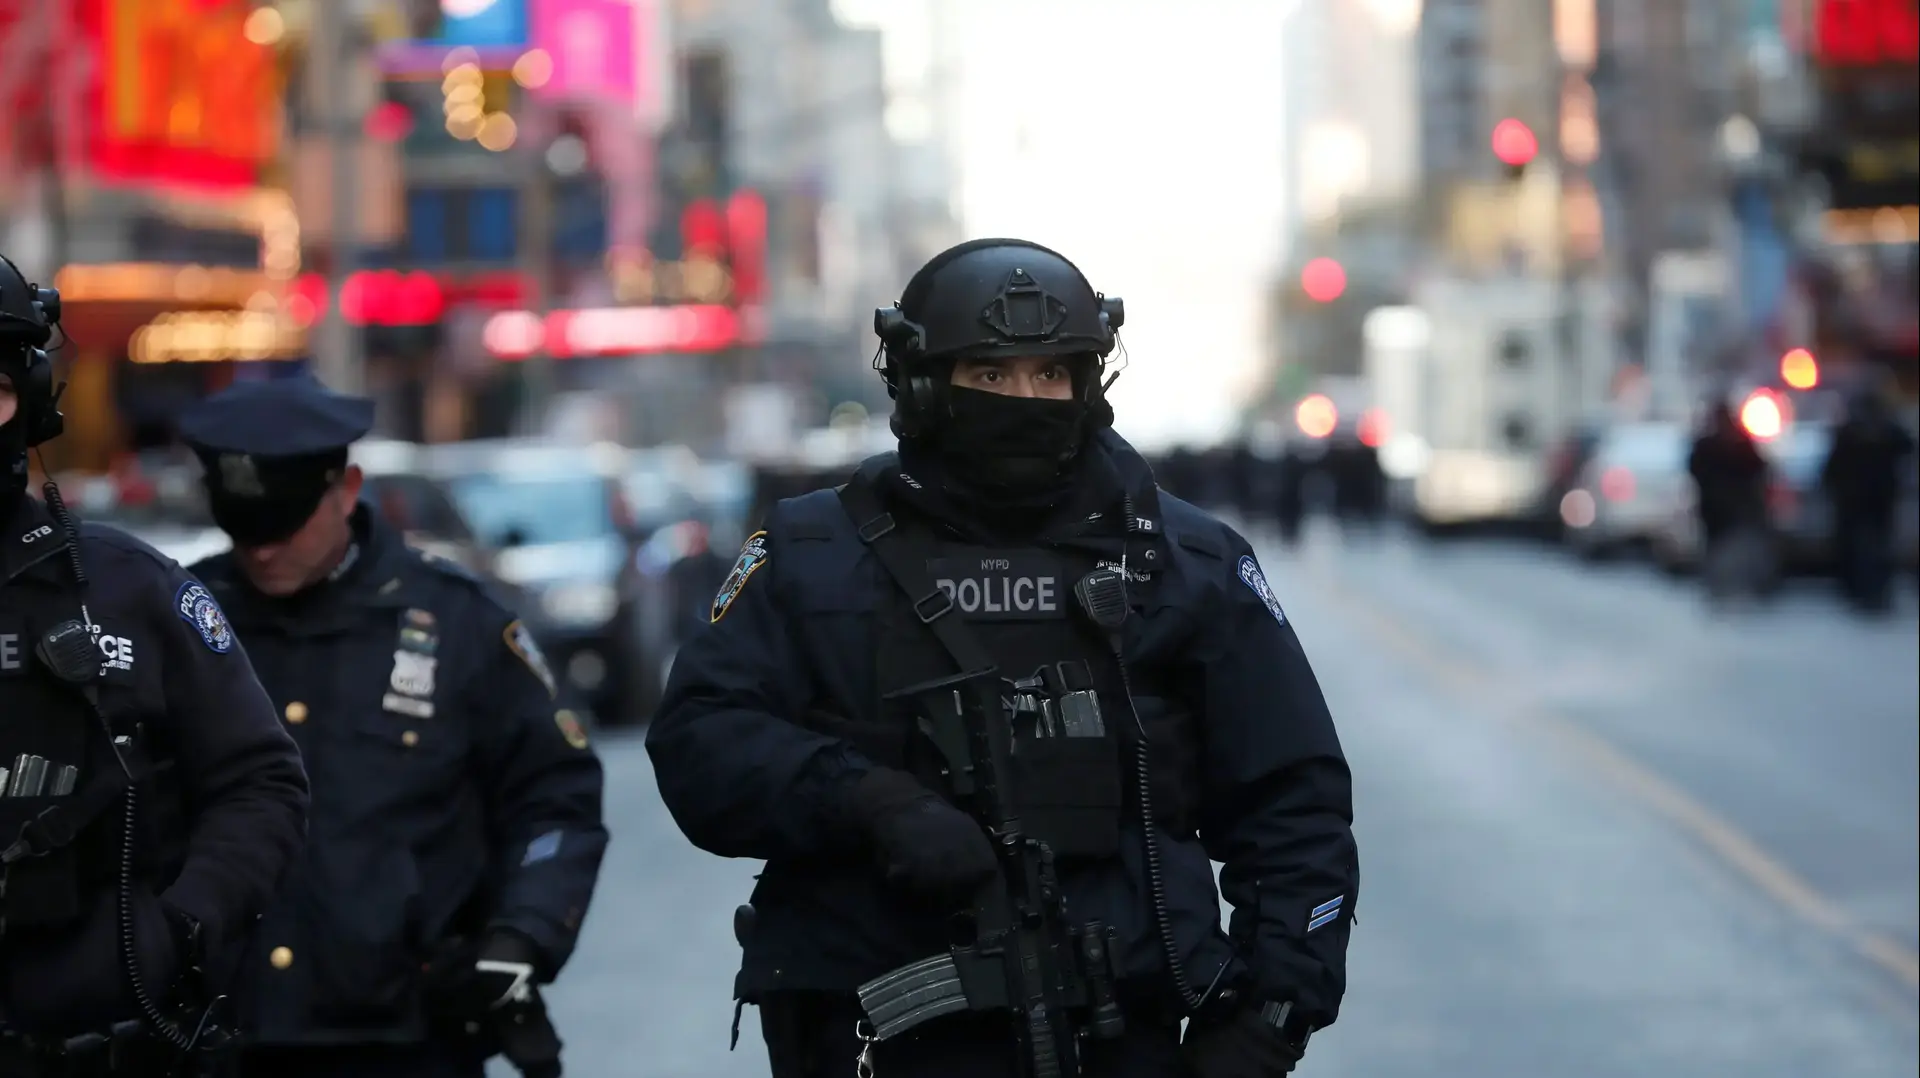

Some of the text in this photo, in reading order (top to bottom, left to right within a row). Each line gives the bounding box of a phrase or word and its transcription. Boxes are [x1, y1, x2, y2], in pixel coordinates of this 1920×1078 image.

[899, 473, 923, 489] CTB
[1136, 517, 1153, 530] TB
[22, 525, 52, 543] CTB
[981, 559, 1010, 571] NYPD
[936, 576, 1057, 613] POLICE
[98, 634, 134, 663] CE
